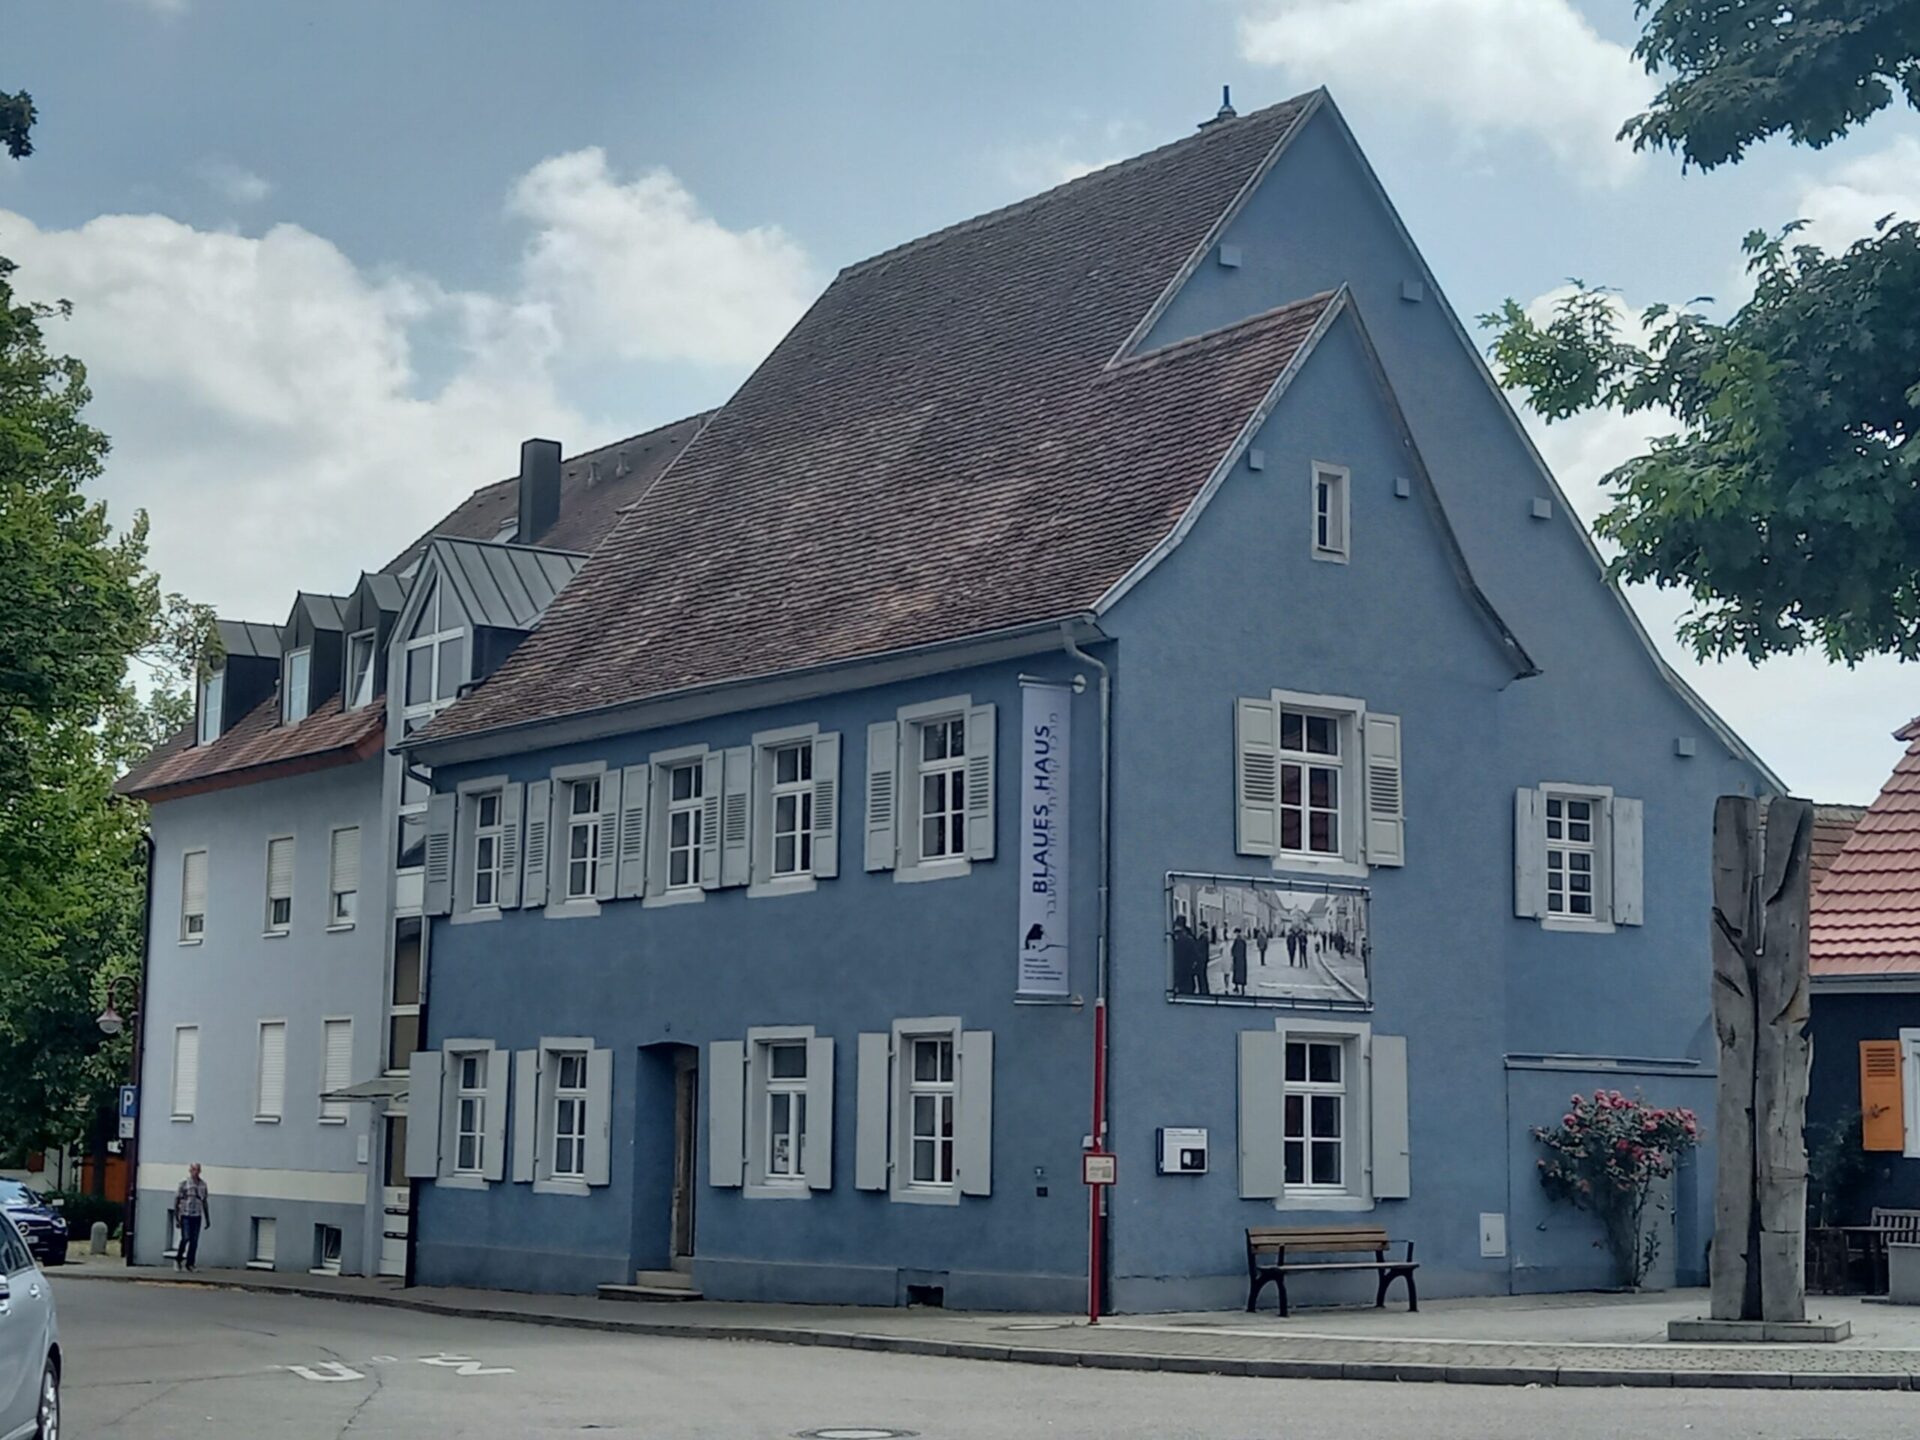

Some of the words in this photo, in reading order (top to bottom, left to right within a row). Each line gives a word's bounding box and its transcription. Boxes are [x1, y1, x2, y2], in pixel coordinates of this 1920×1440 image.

[1033, 725, 1050, 791] HAUS
[1032, 804, 1049, 893] BLAUES
[123, 1090, 134, 1115] P
